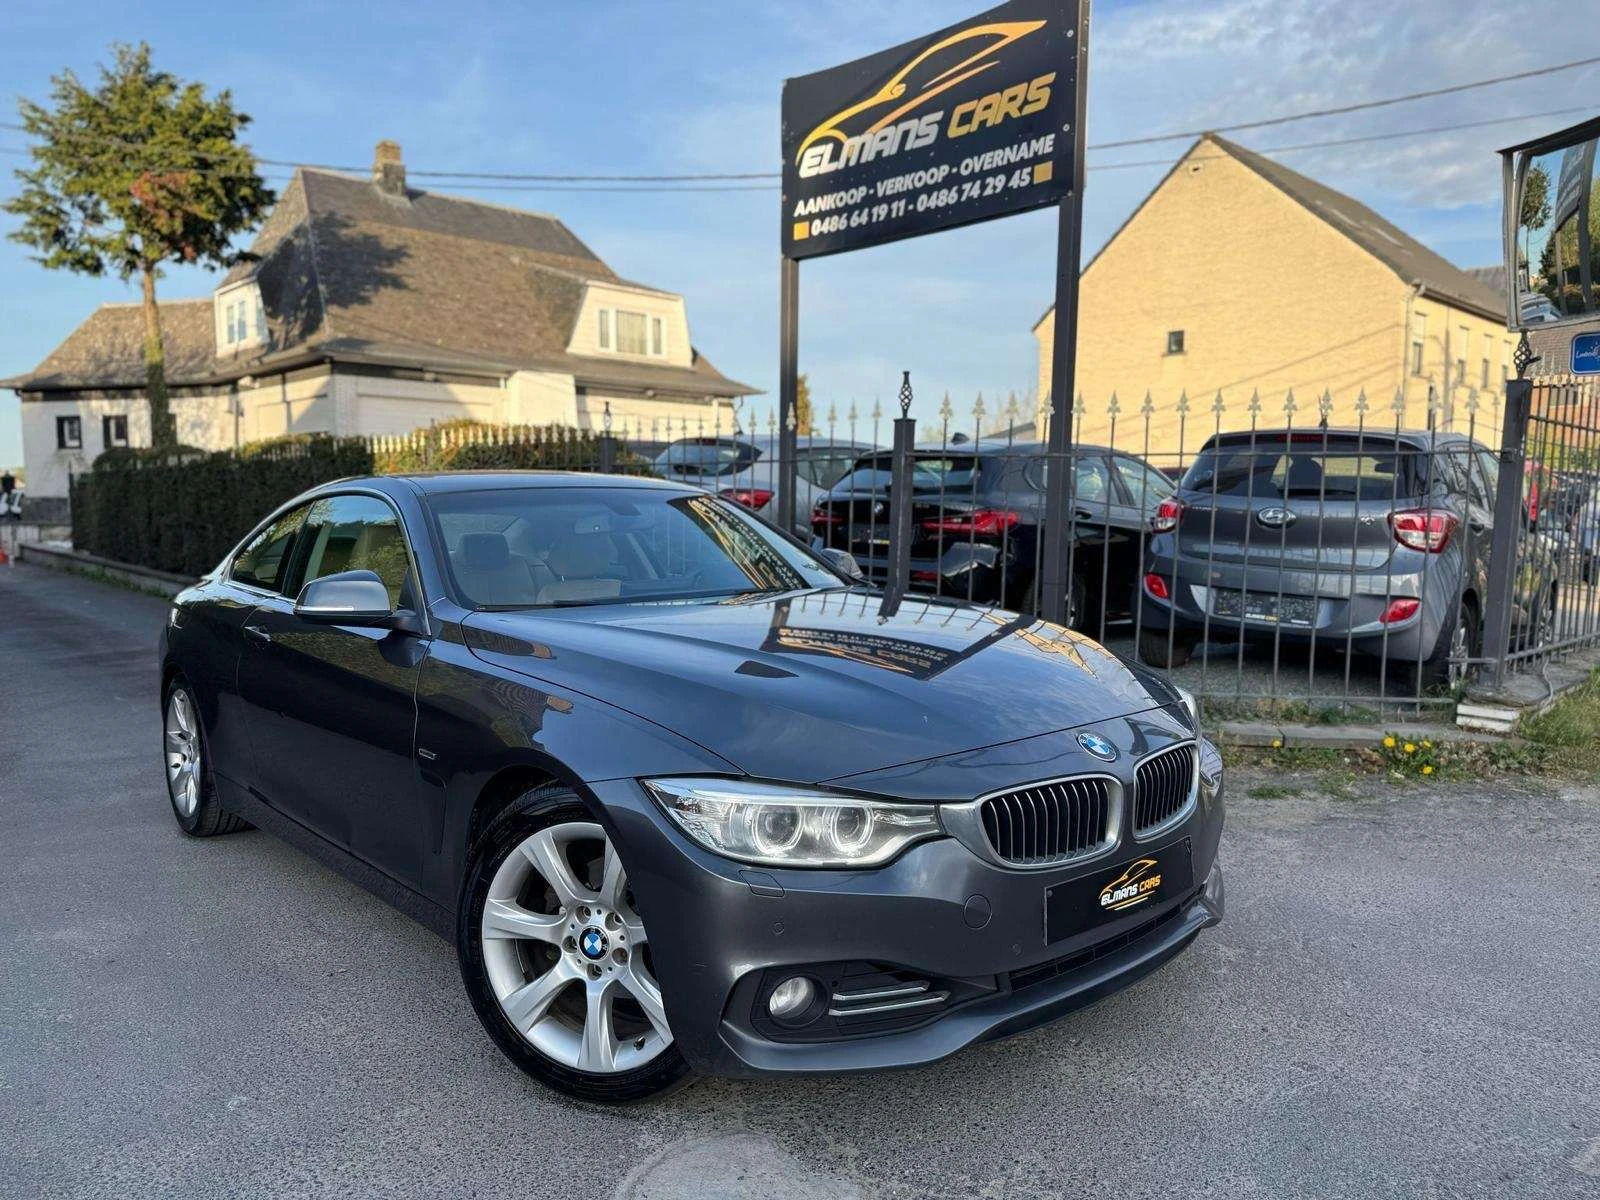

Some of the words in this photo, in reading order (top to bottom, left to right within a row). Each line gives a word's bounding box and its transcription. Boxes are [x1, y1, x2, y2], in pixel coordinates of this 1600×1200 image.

[799, 110, 944, 178] ELMANS
[947, 71, 1057, 138] CARS
[793, 185, 867, 217] AANKOOP
[876, 164, 950, 198] VERKOOP
[960, 133, 1056, 176] OVERNAME
[811, 213, 848, 236] 0486
[849, 208, 870, 228] 64
[871, 203, 889, 223] 19
[891, 199, 906, 218] 11
[916, 185, 959, 213] 0486
[961, 180, 981, 202] 74
[982, 174, 1007, 197] 29
[1008, 166, 1032, 189] 45
[1139, 874, 1161, 892] CARS
